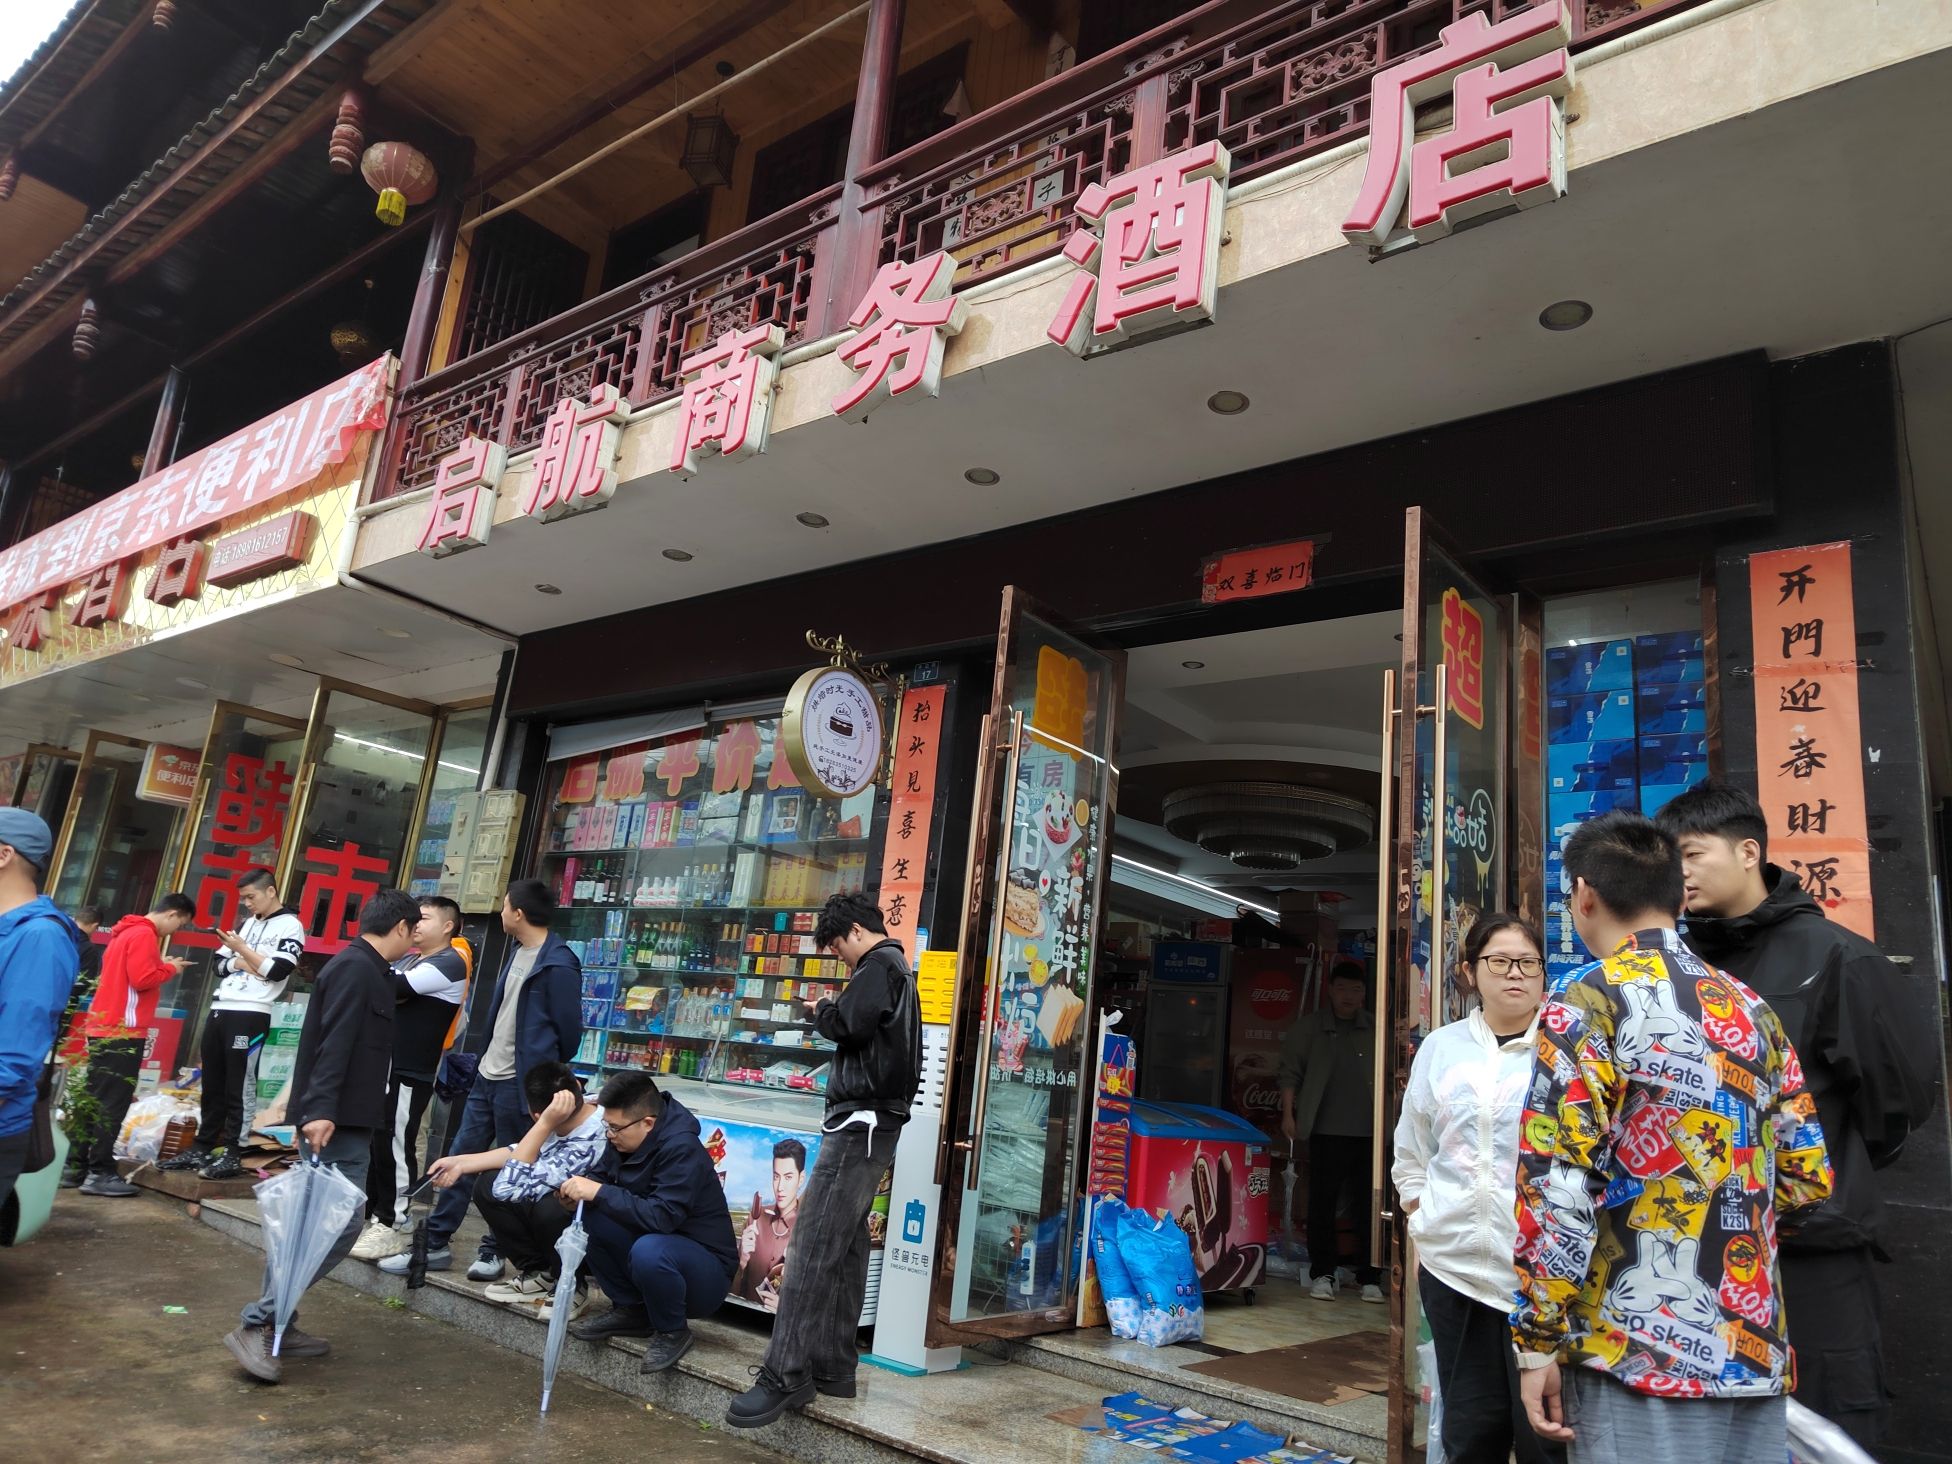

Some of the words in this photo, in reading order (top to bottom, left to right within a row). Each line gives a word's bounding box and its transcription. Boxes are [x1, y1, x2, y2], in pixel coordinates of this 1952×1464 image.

[415, 0, 1570, 552] 启航商务酒店
[1218, 560, 1307, 592] 双喜临门
[922, 670, 931, 680] 17
[1442, 587, 1484, 730] 超
[1648, 1059, 1706, 1092] skate.
[1652, 1323, 1715, 1365] skate.
